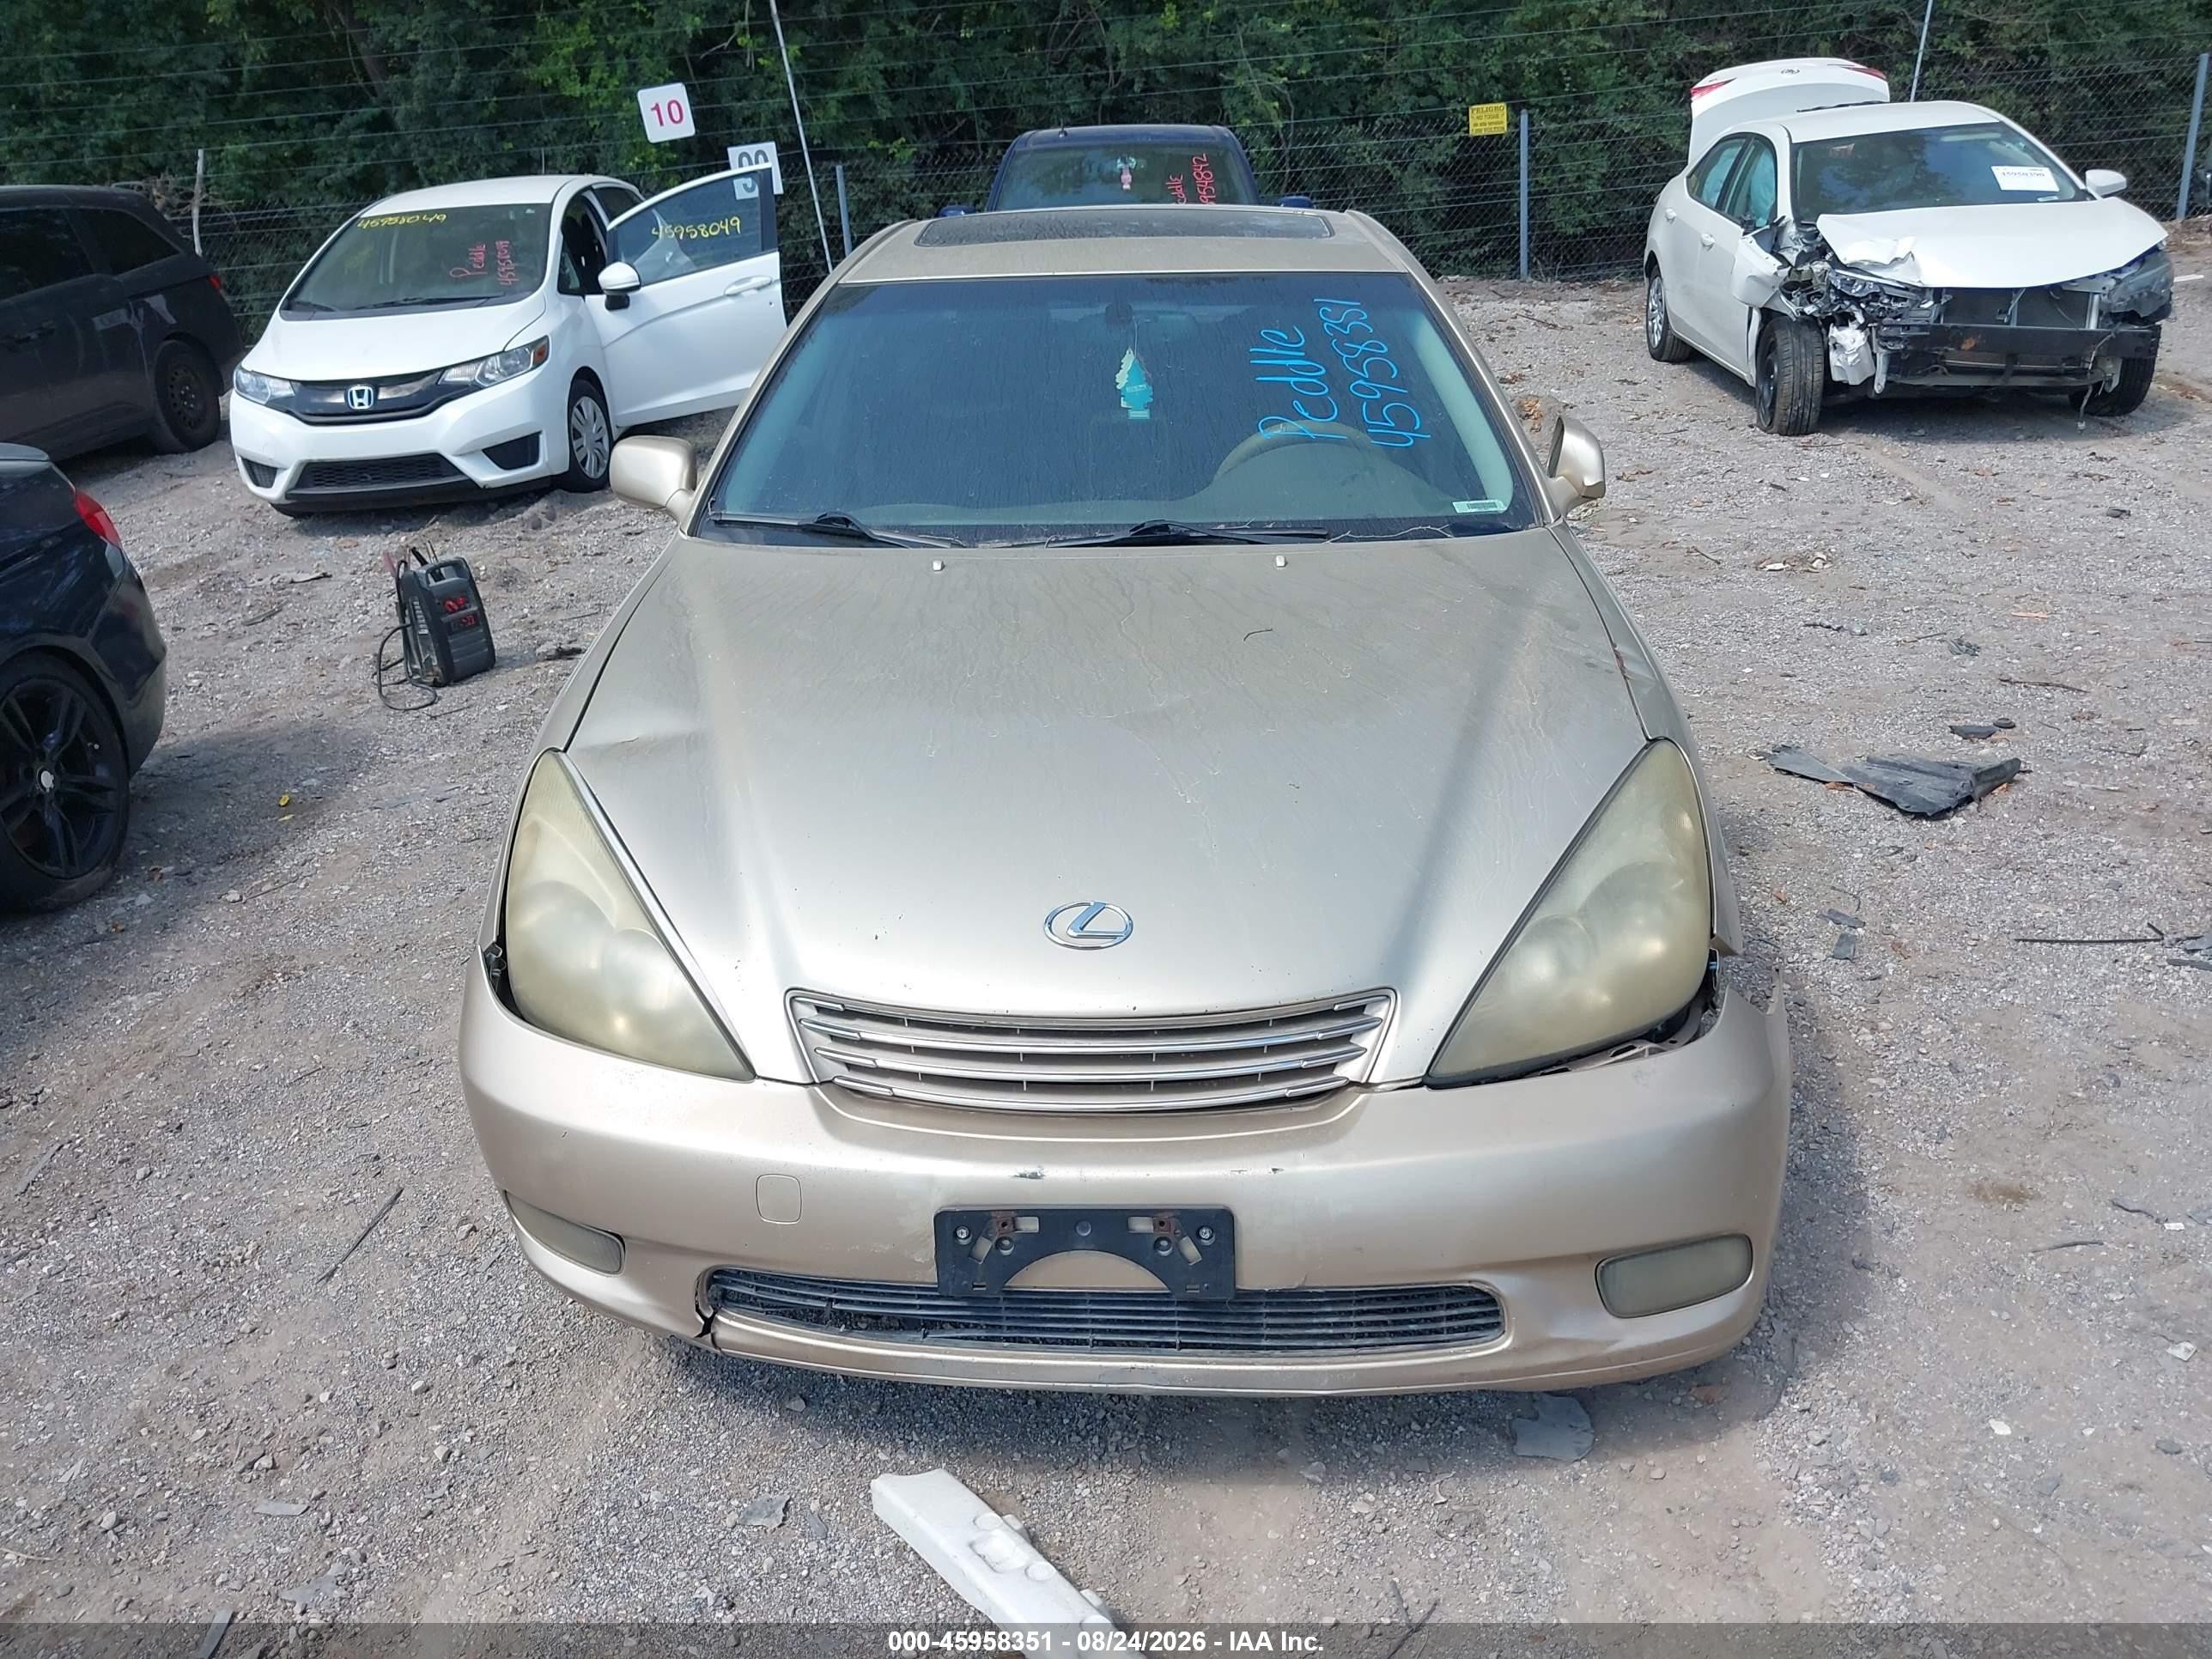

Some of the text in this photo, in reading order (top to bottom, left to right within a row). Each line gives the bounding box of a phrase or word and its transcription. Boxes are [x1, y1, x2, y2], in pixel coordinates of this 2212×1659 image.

[651, 99, 684, 127] 10
[651, 216, 741, 240] 45958049
[1249, 325, 1347, 440] Peddle
[1313, 298, 1431, 447] 45958351
